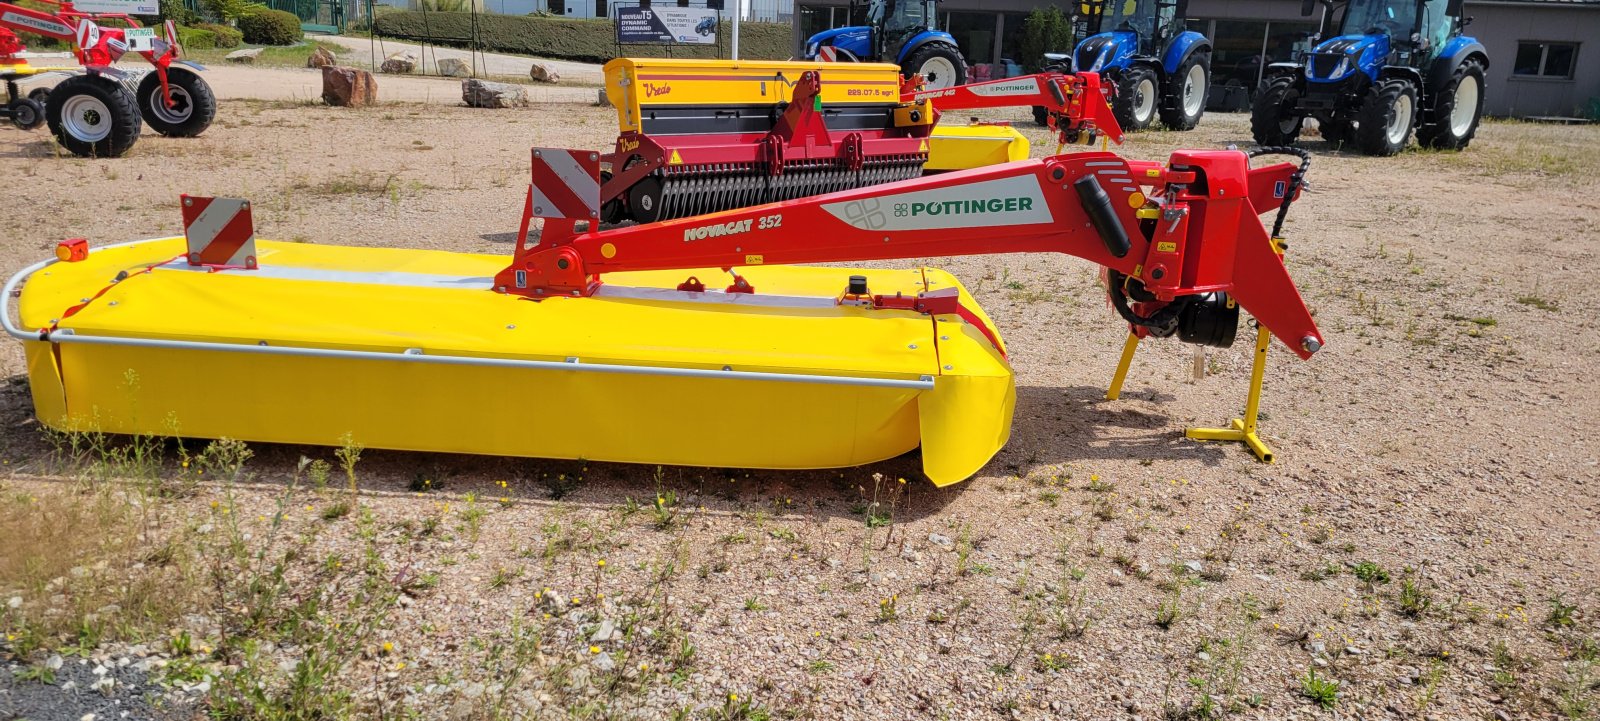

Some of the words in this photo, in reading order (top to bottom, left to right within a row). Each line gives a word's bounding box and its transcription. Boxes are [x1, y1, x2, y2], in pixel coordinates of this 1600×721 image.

[641, 10, 652, 20] T5
[91, 27, 98, 39] 40
[643, 82, 671, 98] Vredo
[619, 136, 640, 153] Vredo
[683, 219, 754, 242] NOVACAT
[758, 214, 783, 230] 352
